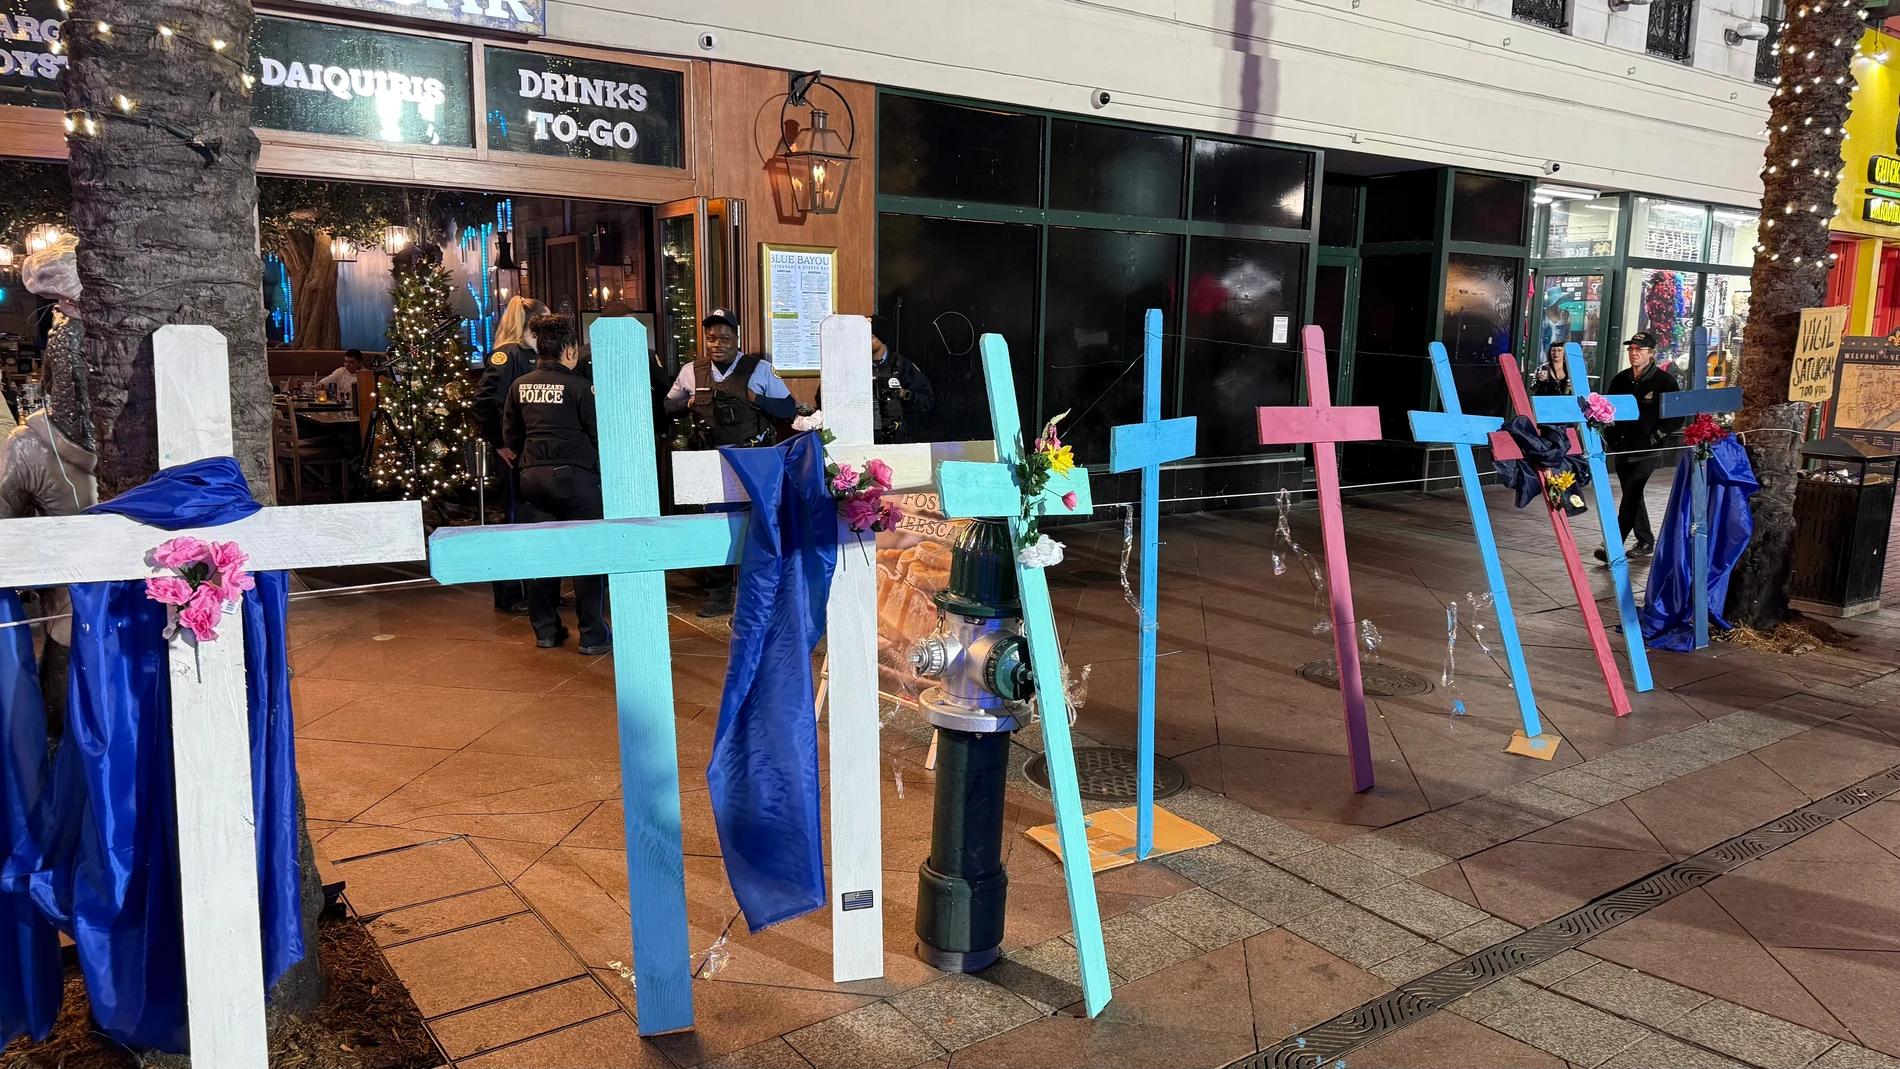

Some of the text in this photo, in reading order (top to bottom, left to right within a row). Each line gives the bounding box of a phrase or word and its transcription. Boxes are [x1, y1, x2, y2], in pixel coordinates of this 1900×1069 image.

[260, 57, 446, 105] DAIQUIRIS
[518, 68, 648, 112] DRINKS
[528, 109, 639, 149] TO-GO
[797, 255, 830, 266] BAYOU
[519, 390, 563, 403] POLICE
